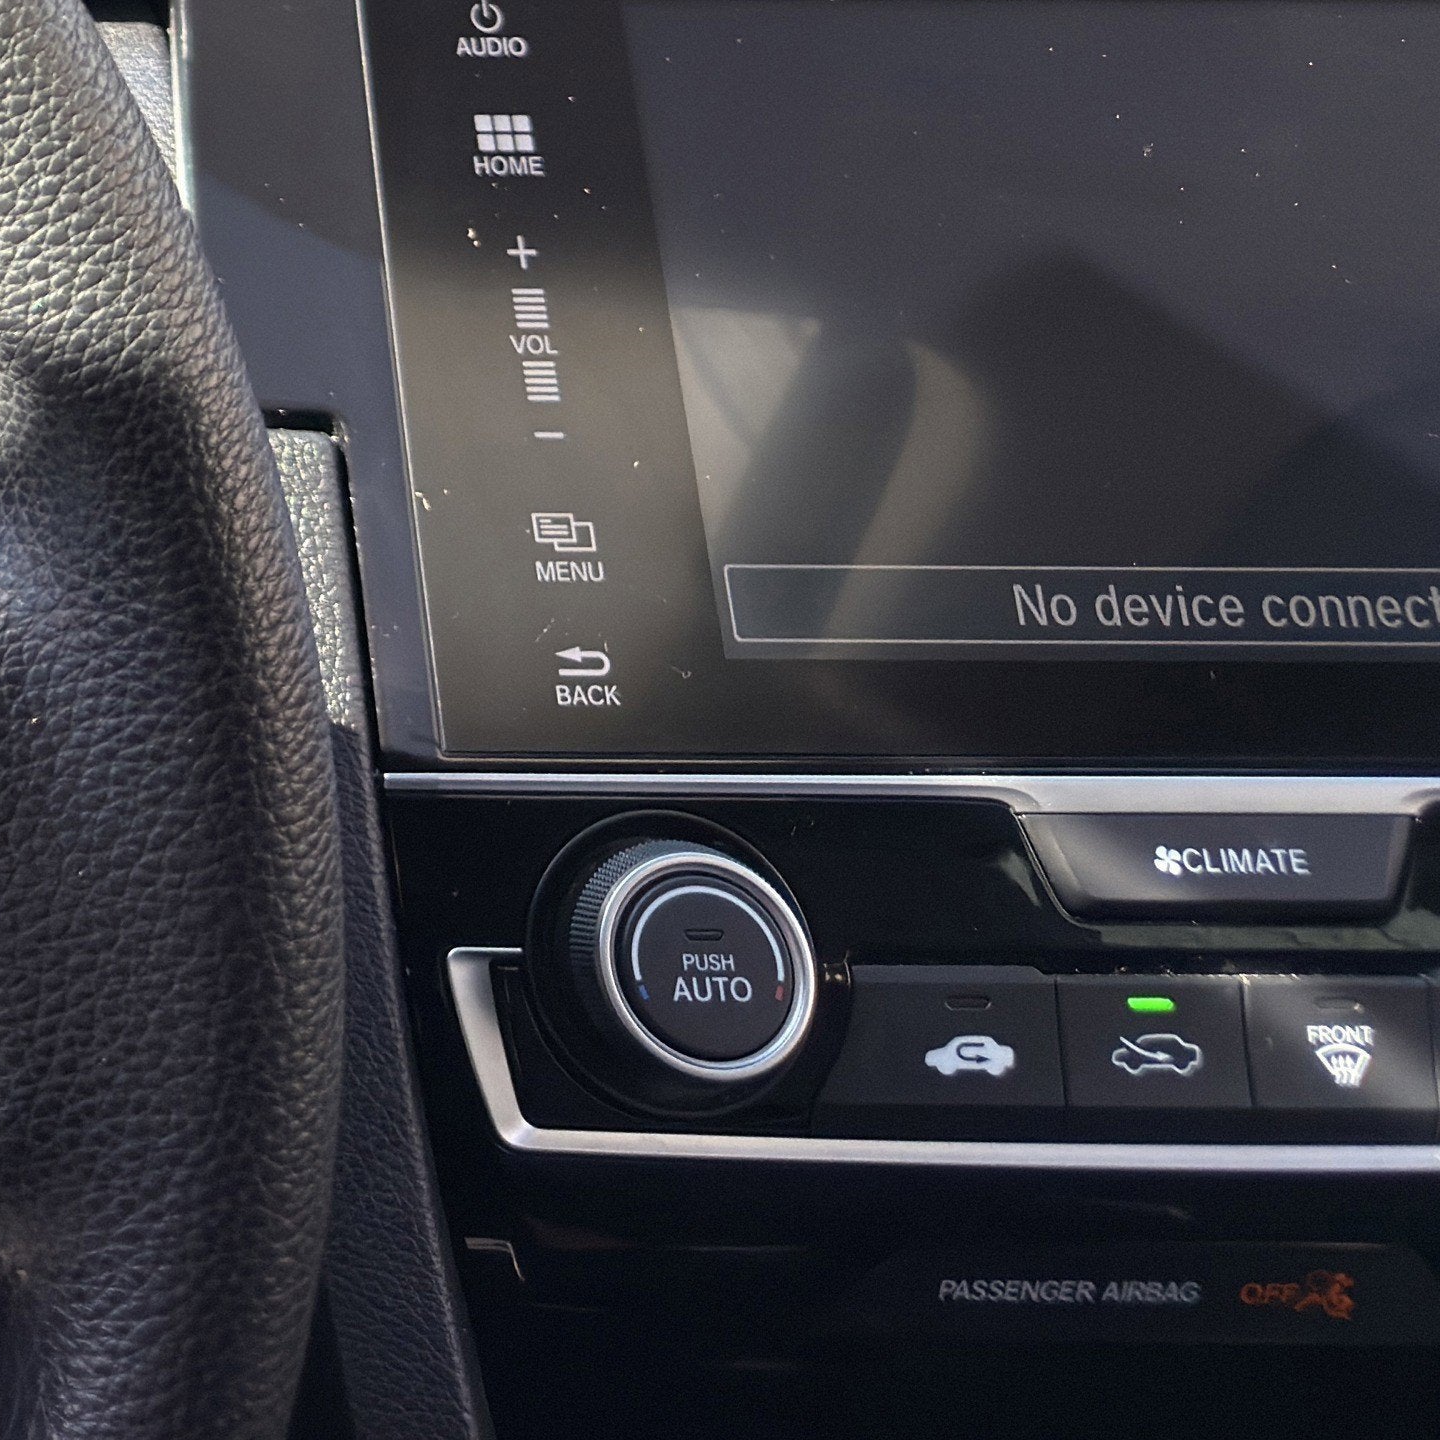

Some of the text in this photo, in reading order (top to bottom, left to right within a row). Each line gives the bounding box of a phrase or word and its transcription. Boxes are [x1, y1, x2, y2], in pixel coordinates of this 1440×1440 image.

[456, 36, 528, 58] AUDIO
[473, 155, 545, 177] HOME
[509, 334, 558, 355] VOL
[535, 560, 605, 583] MENU
[1012, 583, 1077, 627] No
[1094, 585, 1245, 628] device
[555, 684, 621, 707] BACK
[1181, 847, 1310, 876] CLIMATE
[682, 953, 735, 972] PUSH
[673, 976, 752, 1002] AUTO
[1306, 1024, 1375, 1046] FRONT
[938, 1279, 1298, 1306] PASSENGER AIRBAG OFF
